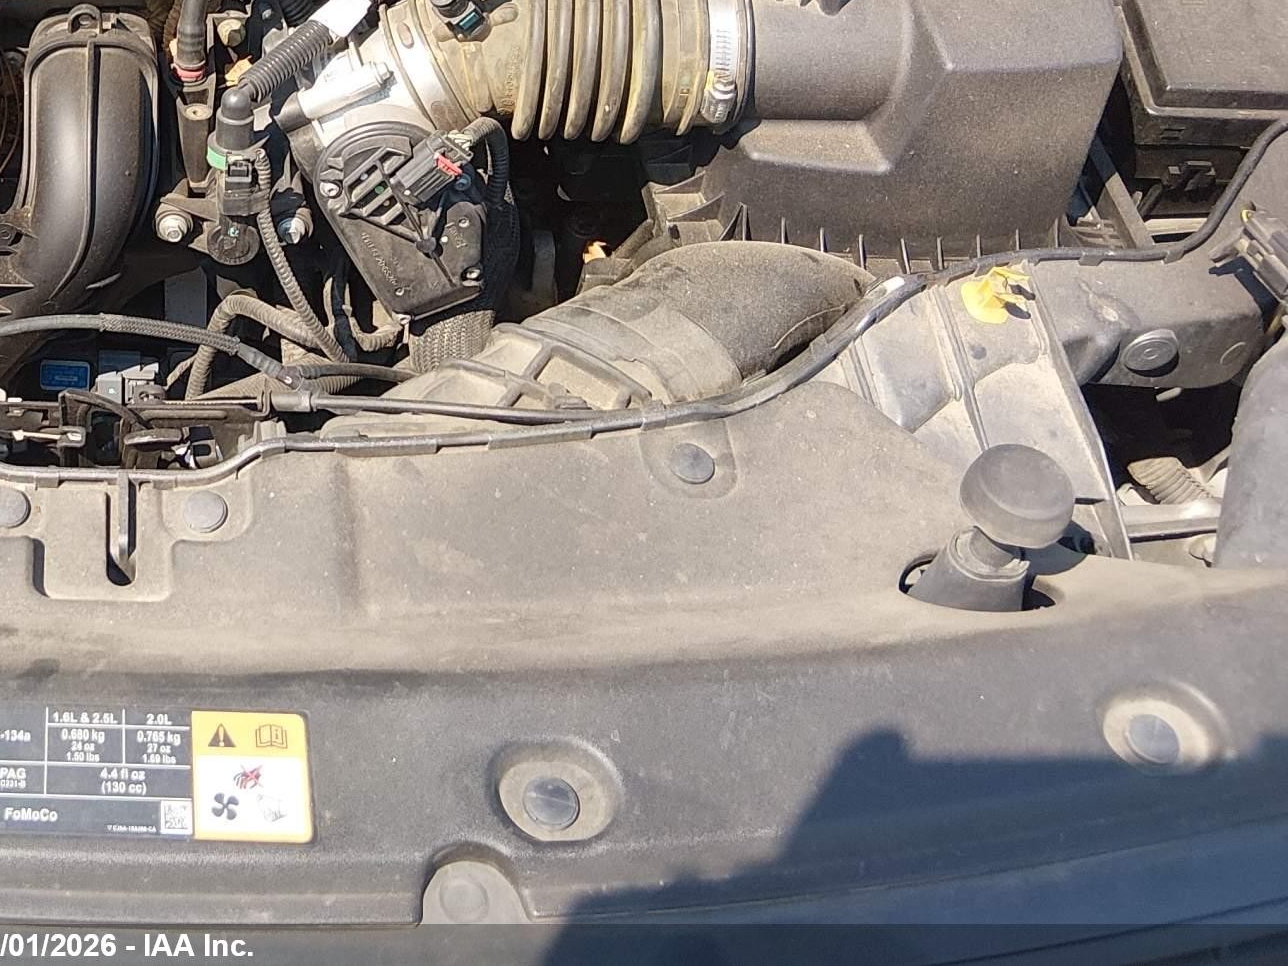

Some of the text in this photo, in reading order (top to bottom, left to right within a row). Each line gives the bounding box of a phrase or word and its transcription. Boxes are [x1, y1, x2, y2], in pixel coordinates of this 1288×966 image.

[53, 711, 118, 725] 1.6L & 2.5L
[146, 713, 173, 726] 2.0L
[61, 728, 105, 744] 0.680 kg
[136, 730, 181, 746] 0.765 kg
[71, 741, 95, 752] 24 oz
[146, 743, 171, 754] 27 oz
[66, 752, 100, 762] 1.50 lbs
[162, 754, 176, 765] lbs
[0, 767, 27, 780] PAG
[100, 767, 146, 781] 4.4 fl oz
[101, 780, 147, 796] (130 cc)
[4, 807, 58, 822] FoMoCo
